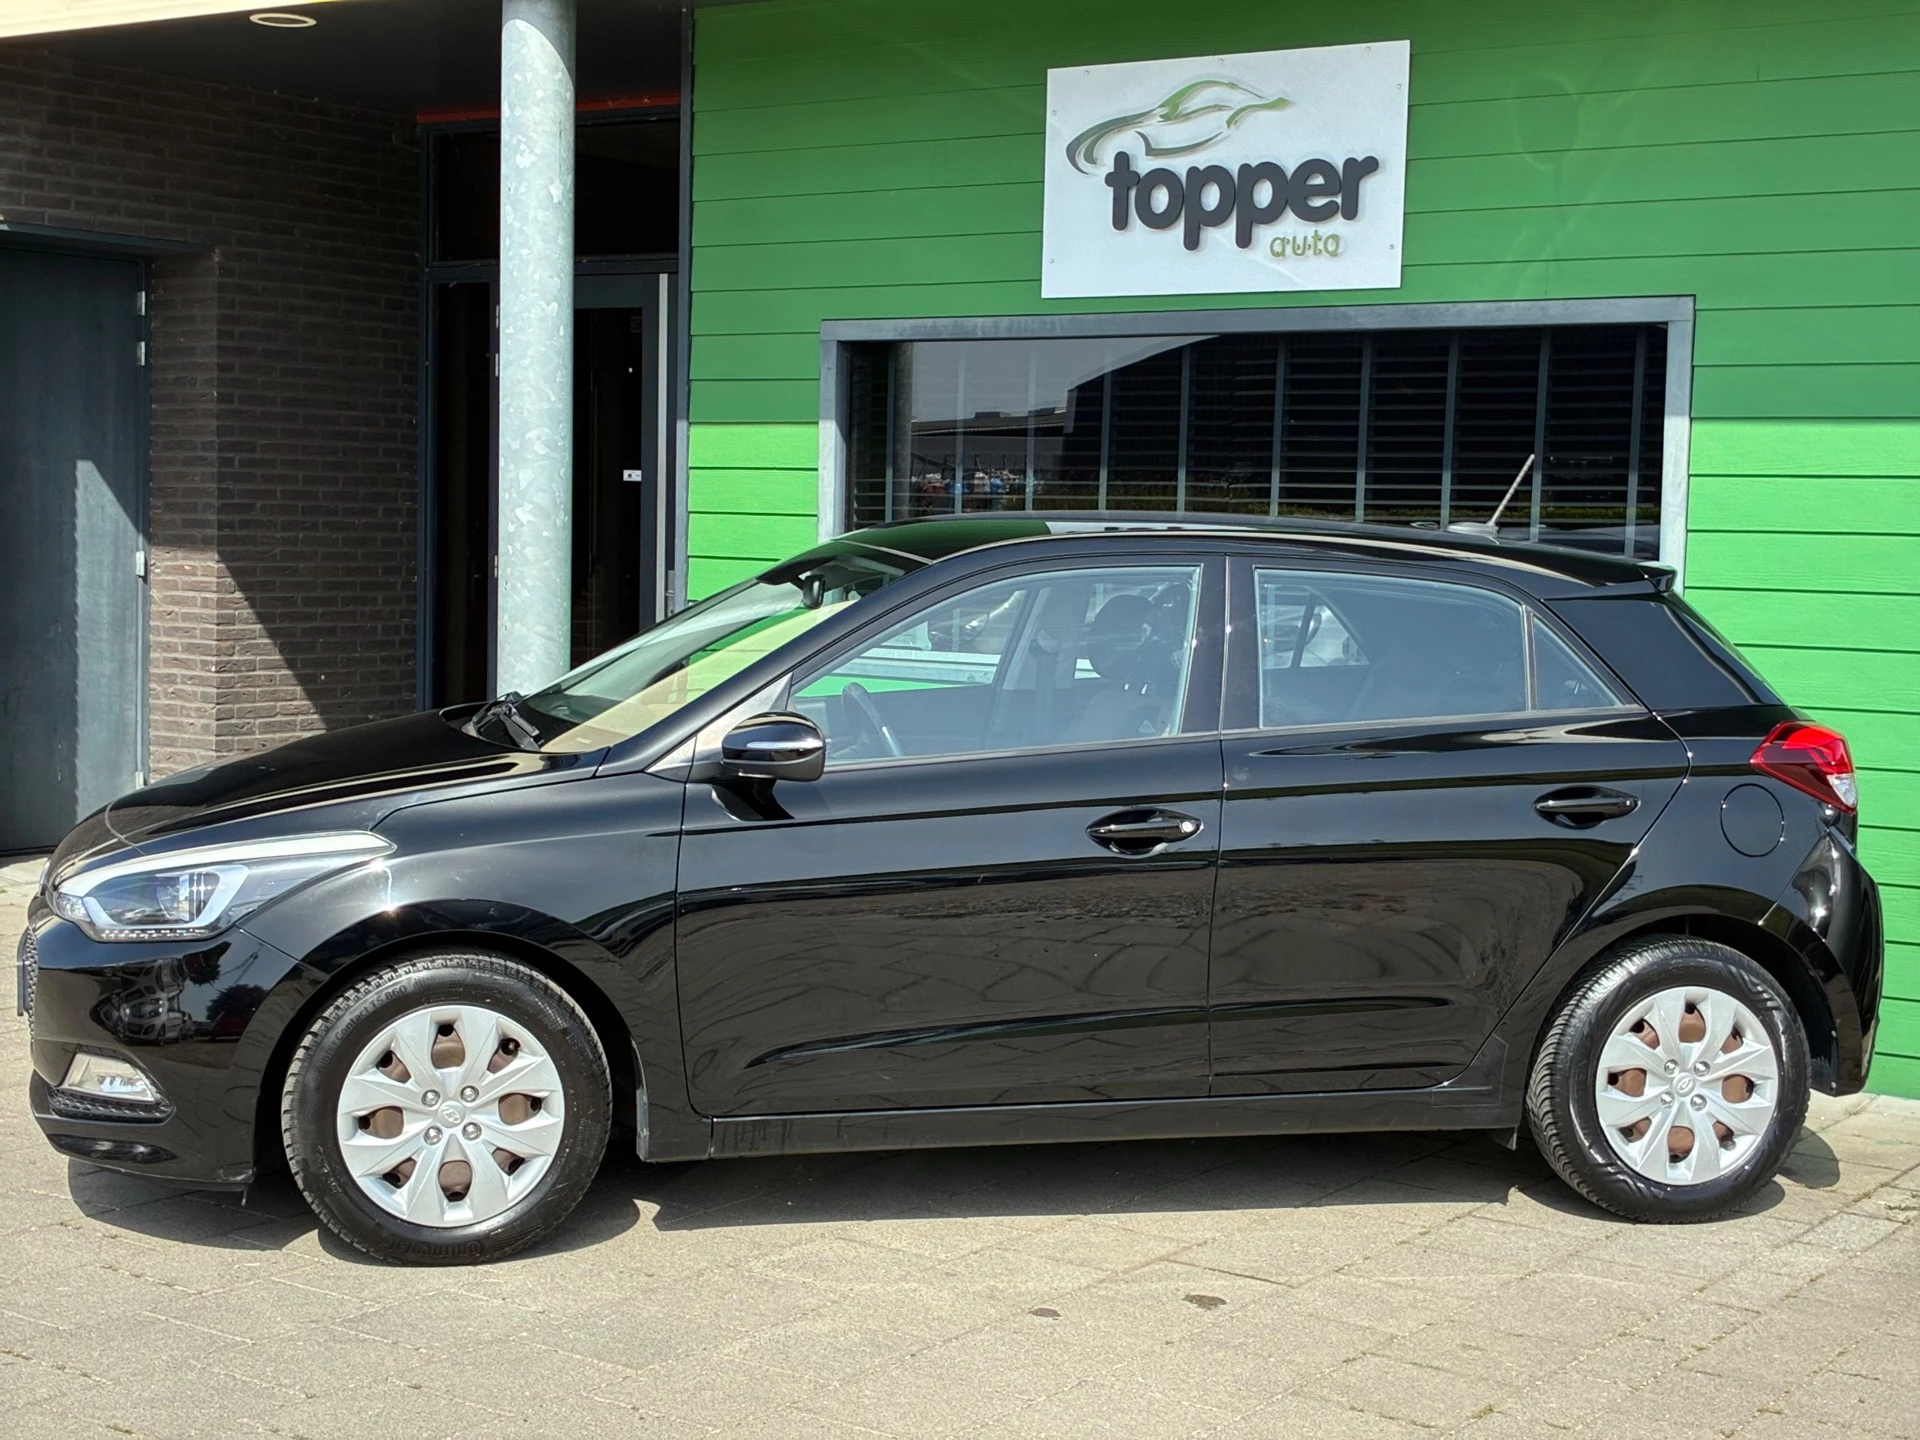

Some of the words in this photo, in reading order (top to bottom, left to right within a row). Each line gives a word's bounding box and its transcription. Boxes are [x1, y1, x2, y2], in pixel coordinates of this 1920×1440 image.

[1104, 150, 1380, 251] topper
[1269, 229, 1341, 257] auto
[370, 996, 385, 1008] TS
[384, 985, 407, 1000] 860
